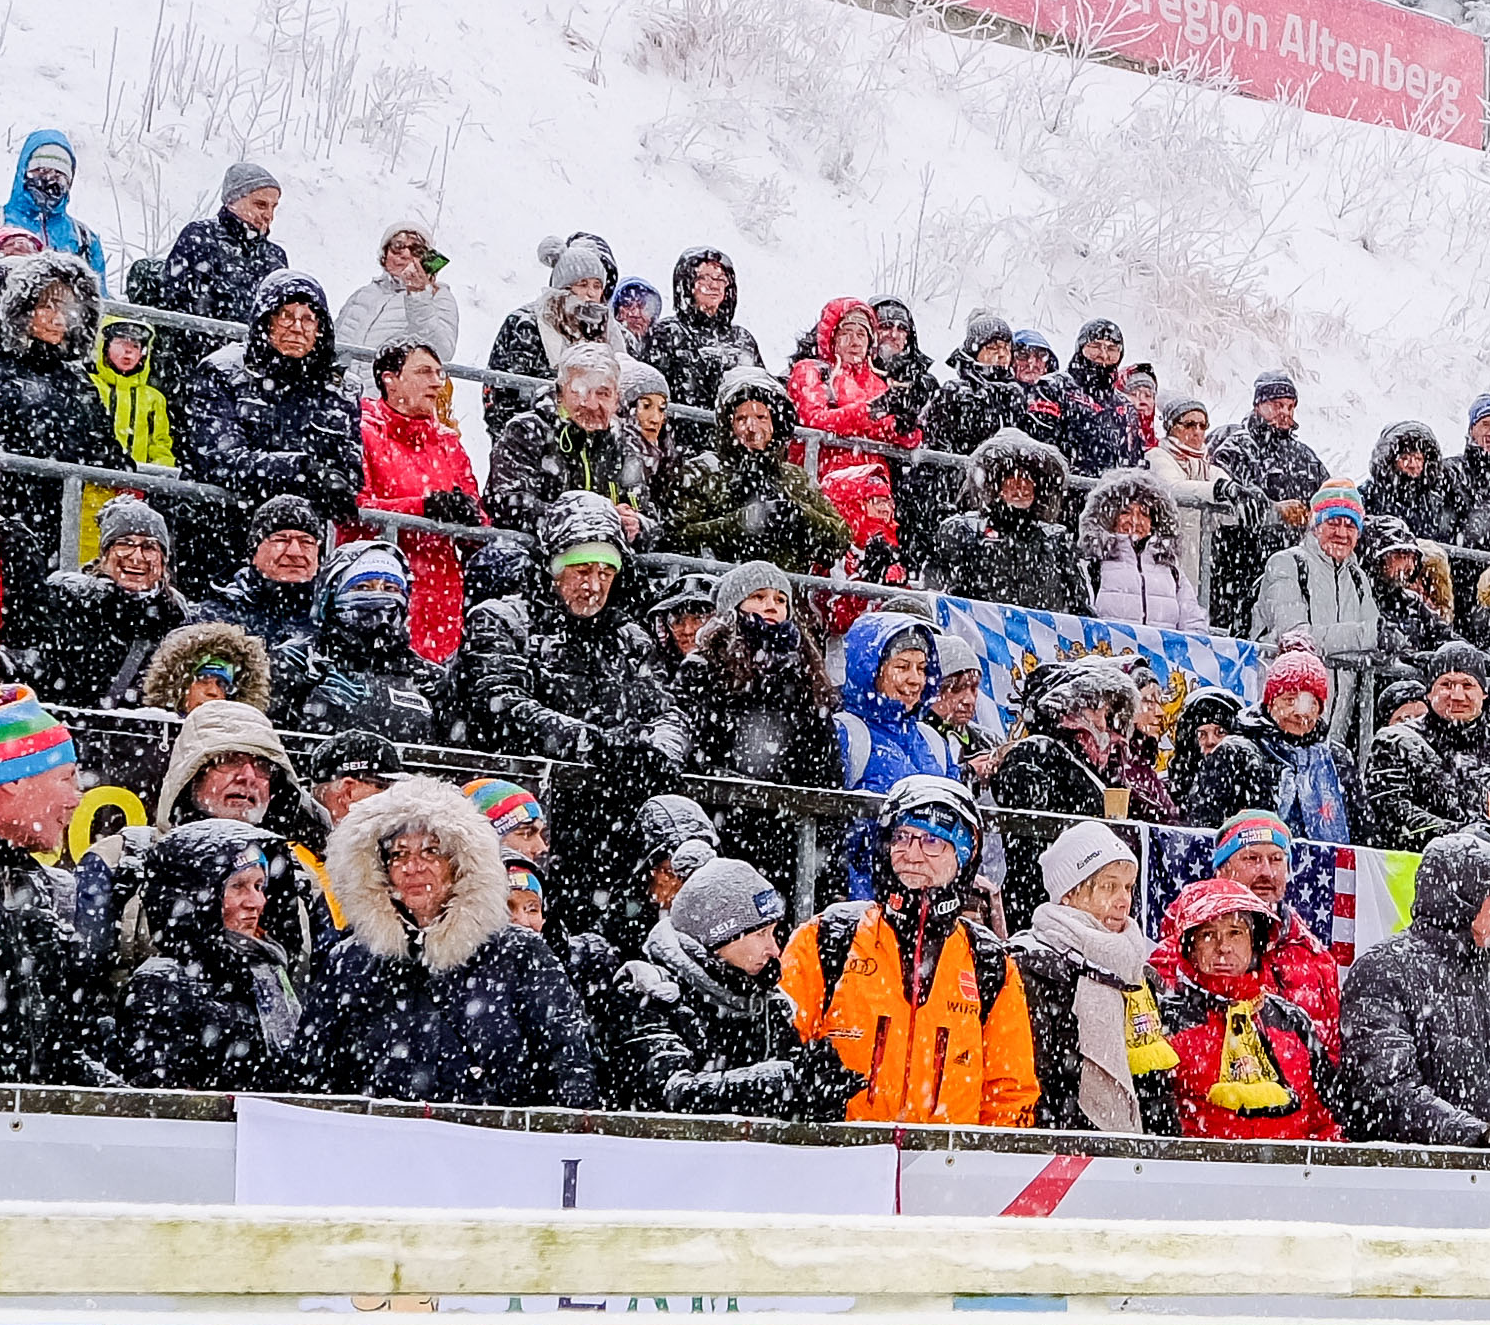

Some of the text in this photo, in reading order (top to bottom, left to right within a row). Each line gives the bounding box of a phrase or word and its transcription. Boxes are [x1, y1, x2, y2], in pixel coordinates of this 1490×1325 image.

[1279, 12, 1462, 125] Altenberg
[342, 760, 369, 772] SEIZ
[710, 918, 737, 937] SEIZ
